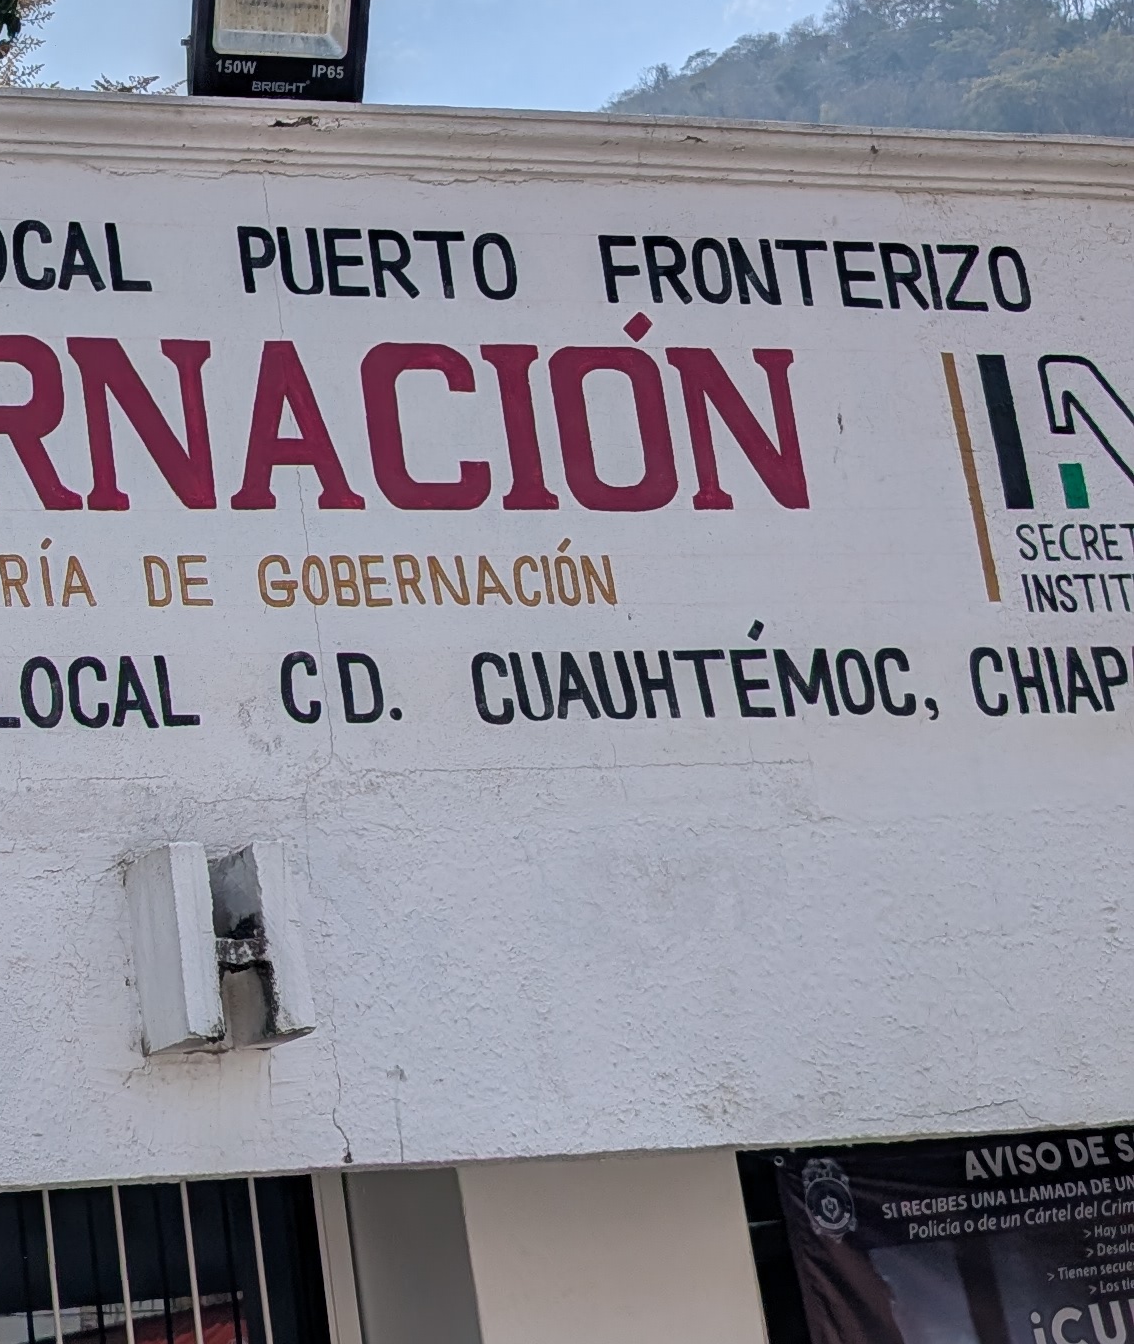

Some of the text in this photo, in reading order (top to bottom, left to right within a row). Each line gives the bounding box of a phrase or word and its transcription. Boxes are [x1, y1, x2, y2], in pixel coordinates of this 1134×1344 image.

[216, 59, 344, 79] 150W IP65
[236, 225, 518, 300] PUERTO
[597, 233, 1032, 312] FRONTERIZO
[144, 555, 214, 608] DE
[258, 538, 618, 608] GOBERNACIÓN
[1020, 573, 1134, 613] INSTIT
[280, 650, 403, 725] CD.
[470, 619, 940, 725] CUAUHTÉMOC,
[969, 646, 1134, 716] CHIAP
[965, 1131, 1134, 1181] AVISO DE S
[882, 1202, 898, 1219] SI
[900, 1194, 968, 1218] RECIBES
[971, 1189, 1007, 1209] UNA
[1010, 1180, 1088, 1204] LLAMADA
[1090, 1177, 1112, 1195] DE
[964, 1220, 975, 1233] o
[978, 1213, 997, 1231] de
[1000, 1212, 1021, 1229] un
[1024, 1202, 1071, 1225] Cártel
[1074, 1200, 1098, 1220] del
[1100, 1260, 1134, 1275] secue
